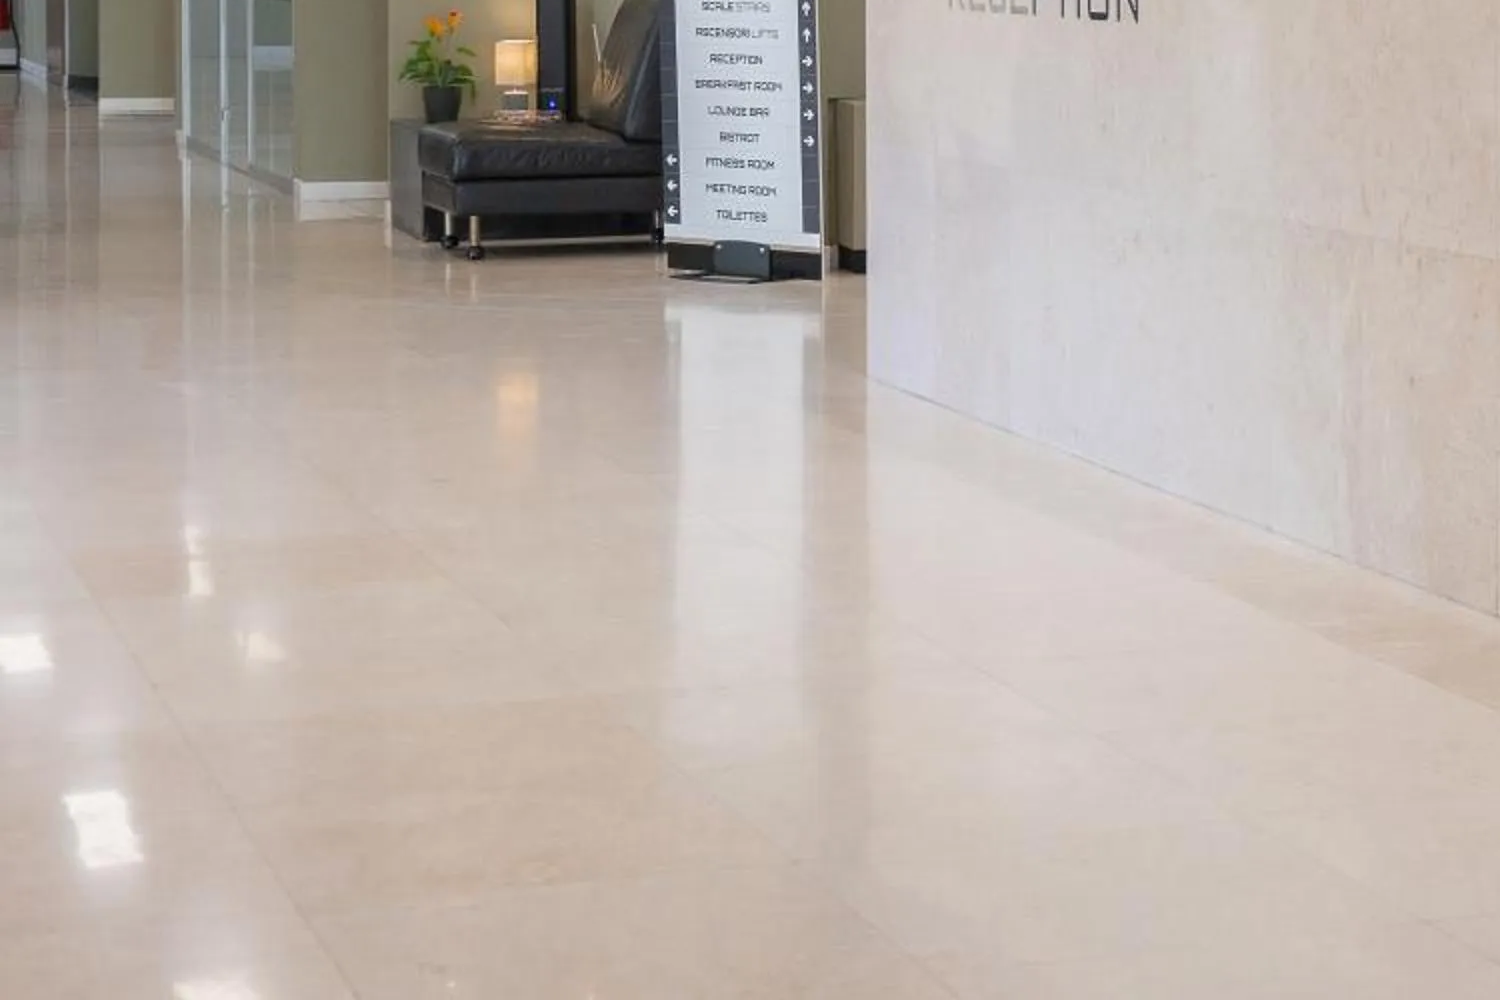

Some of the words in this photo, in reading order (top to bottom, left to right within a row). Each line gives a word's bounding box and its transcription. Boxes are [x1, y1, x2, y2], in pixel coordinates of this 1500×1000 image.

[709, 53, 763, 65] RECEPTION
[695, 79, 752, 91] BREAKFAST
[754, 81, 782, 92] ROOM
[707, 105, 747, 117] LOUNGE
[749, 107, 769, 117] BAR
[719, 131, 761, 143] BISTROT
[705, 157, 745, 169] FITNESS
[747, 159, 775, 170] ROOM
[705, 183, 746, 195] MEETING
[748, 185, 777, 197] ROOM
